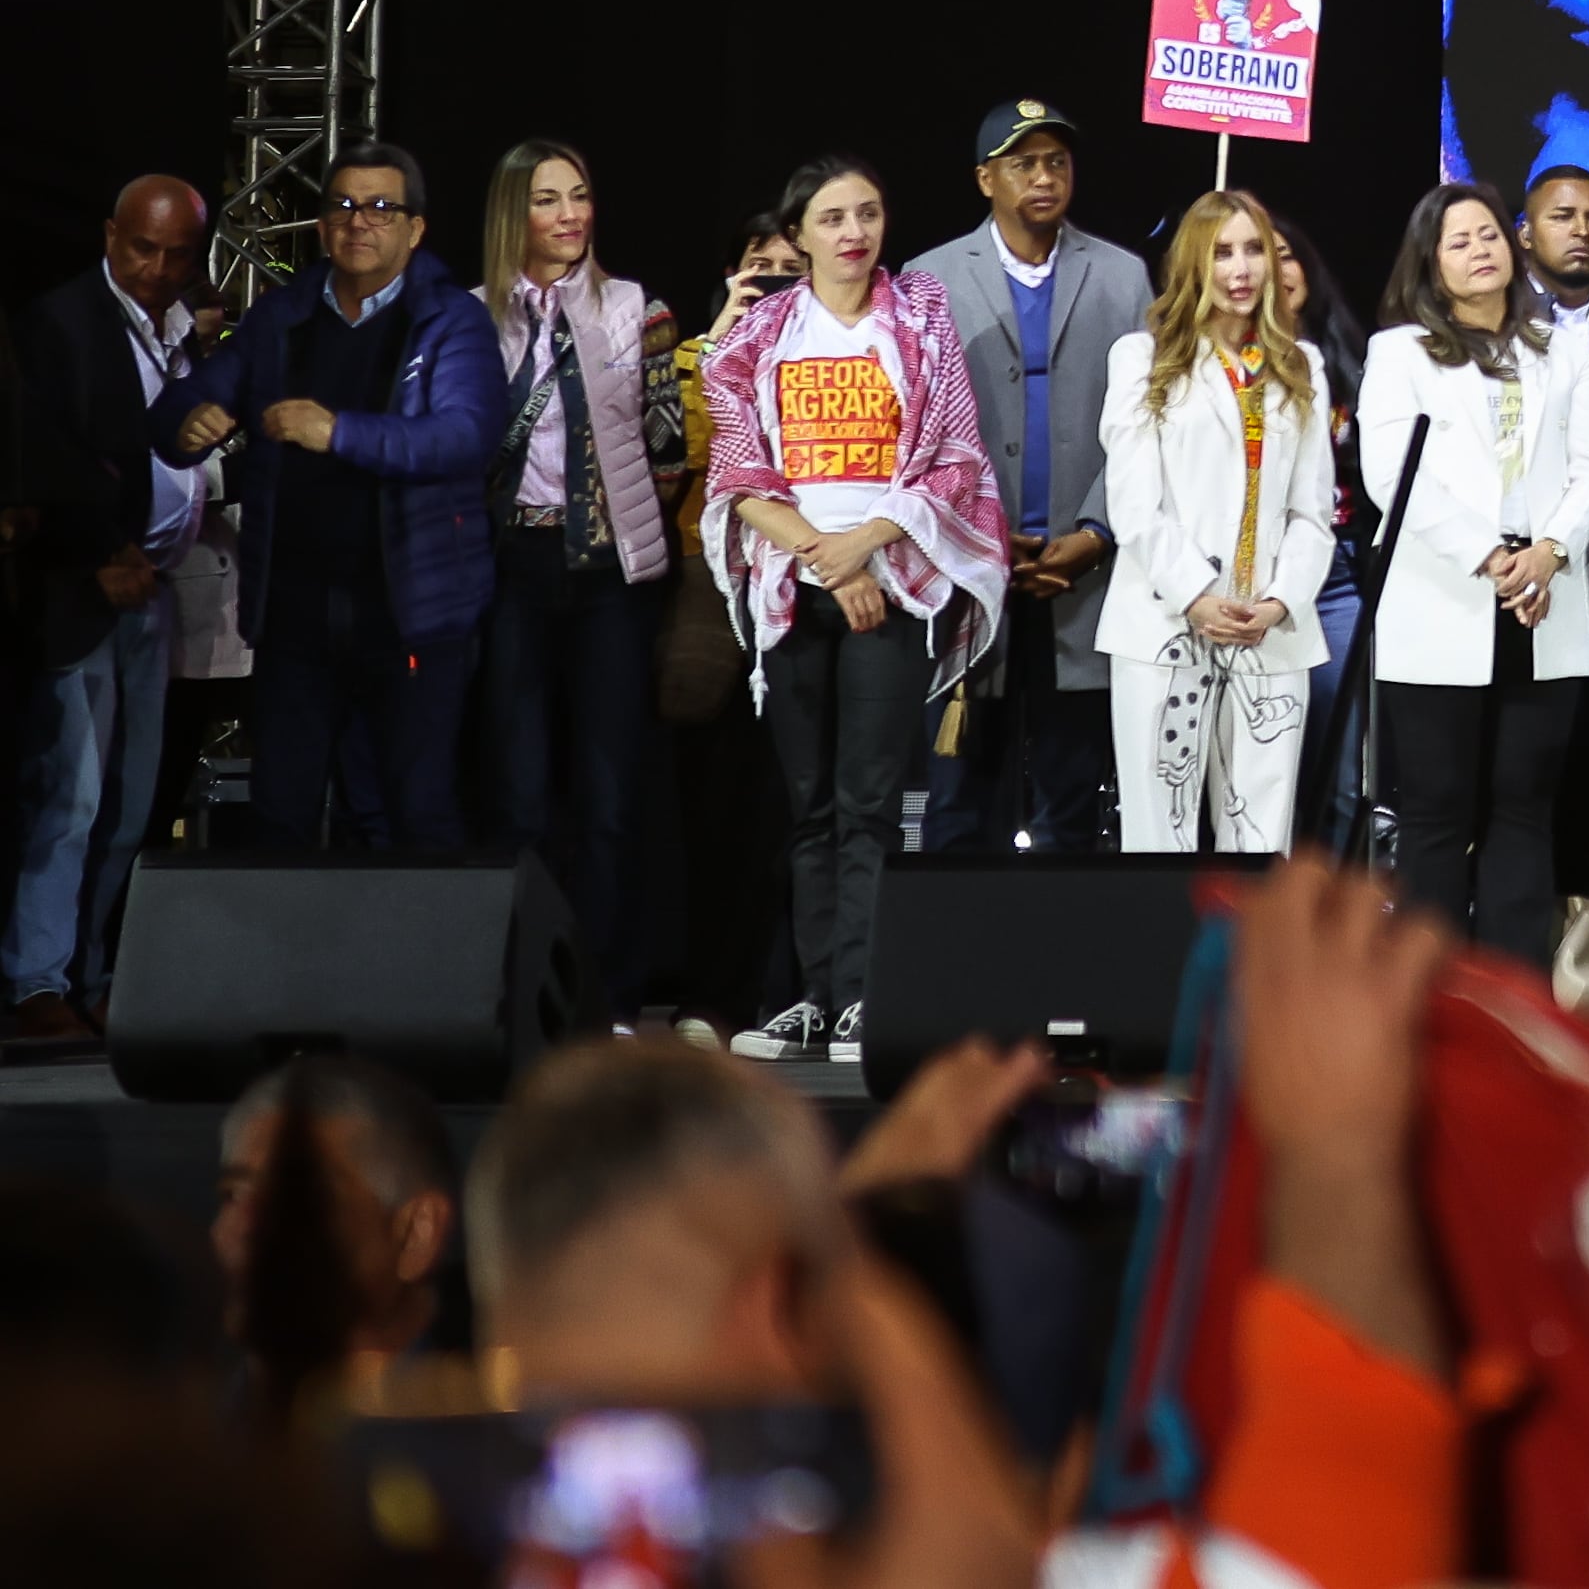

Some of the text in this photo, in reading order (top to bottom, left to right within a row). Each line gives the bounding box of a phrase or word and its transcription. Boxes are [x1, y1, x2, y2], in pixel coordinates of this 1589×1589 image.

[1162, 45, 1299, 90] SOBERANO
[1161, 94, 1293, 124] CONSTITUYENTE
[781, 361, 892, 388] REFORM
